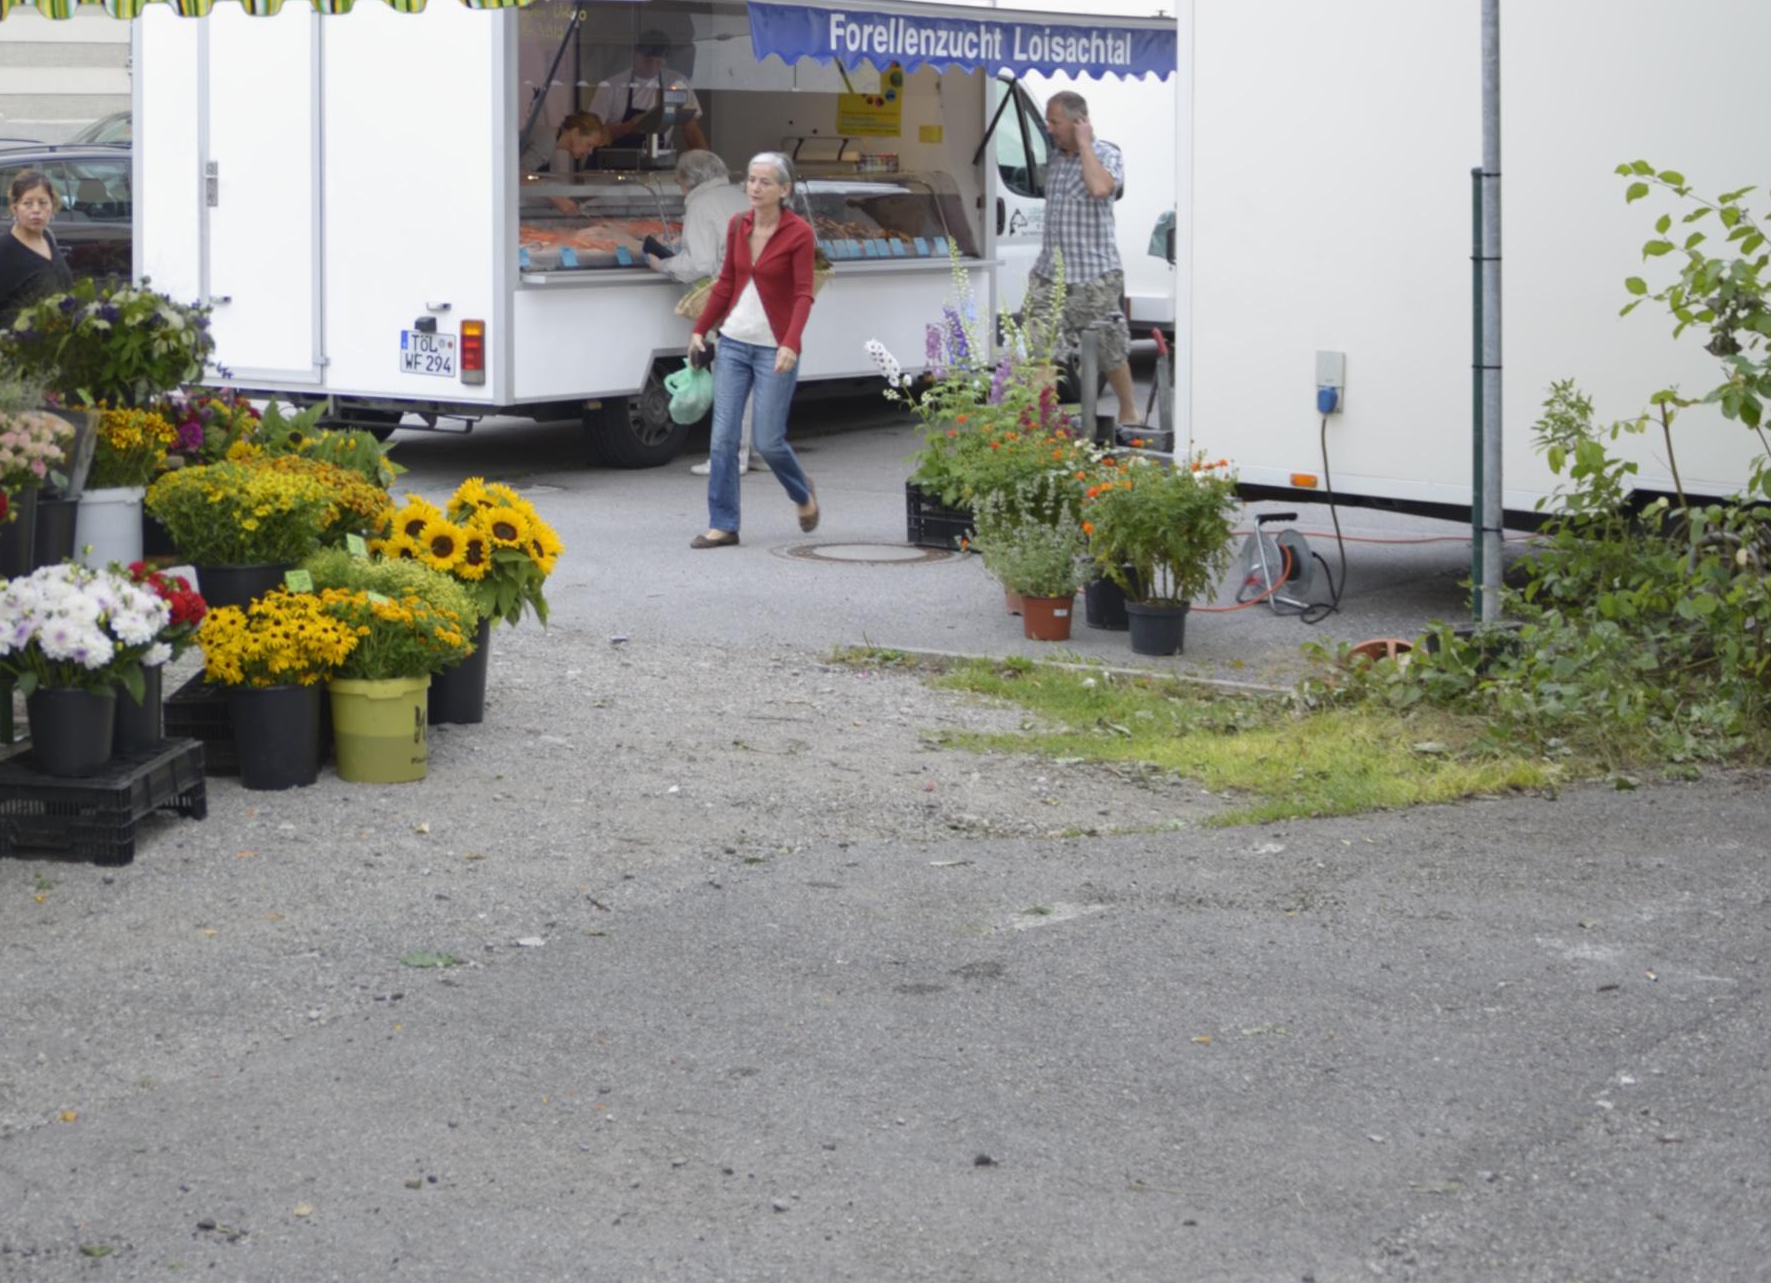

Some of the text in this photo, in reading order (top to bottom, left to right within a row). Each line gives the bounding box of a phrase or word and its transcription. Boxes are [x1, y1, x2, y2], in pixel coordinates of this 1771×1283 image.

[830, 13, 1132, 65] Forellenzucht Loisachtal
[412, 334, 438, 353] TÖL
[405, 353, 451, 373] WF 294
